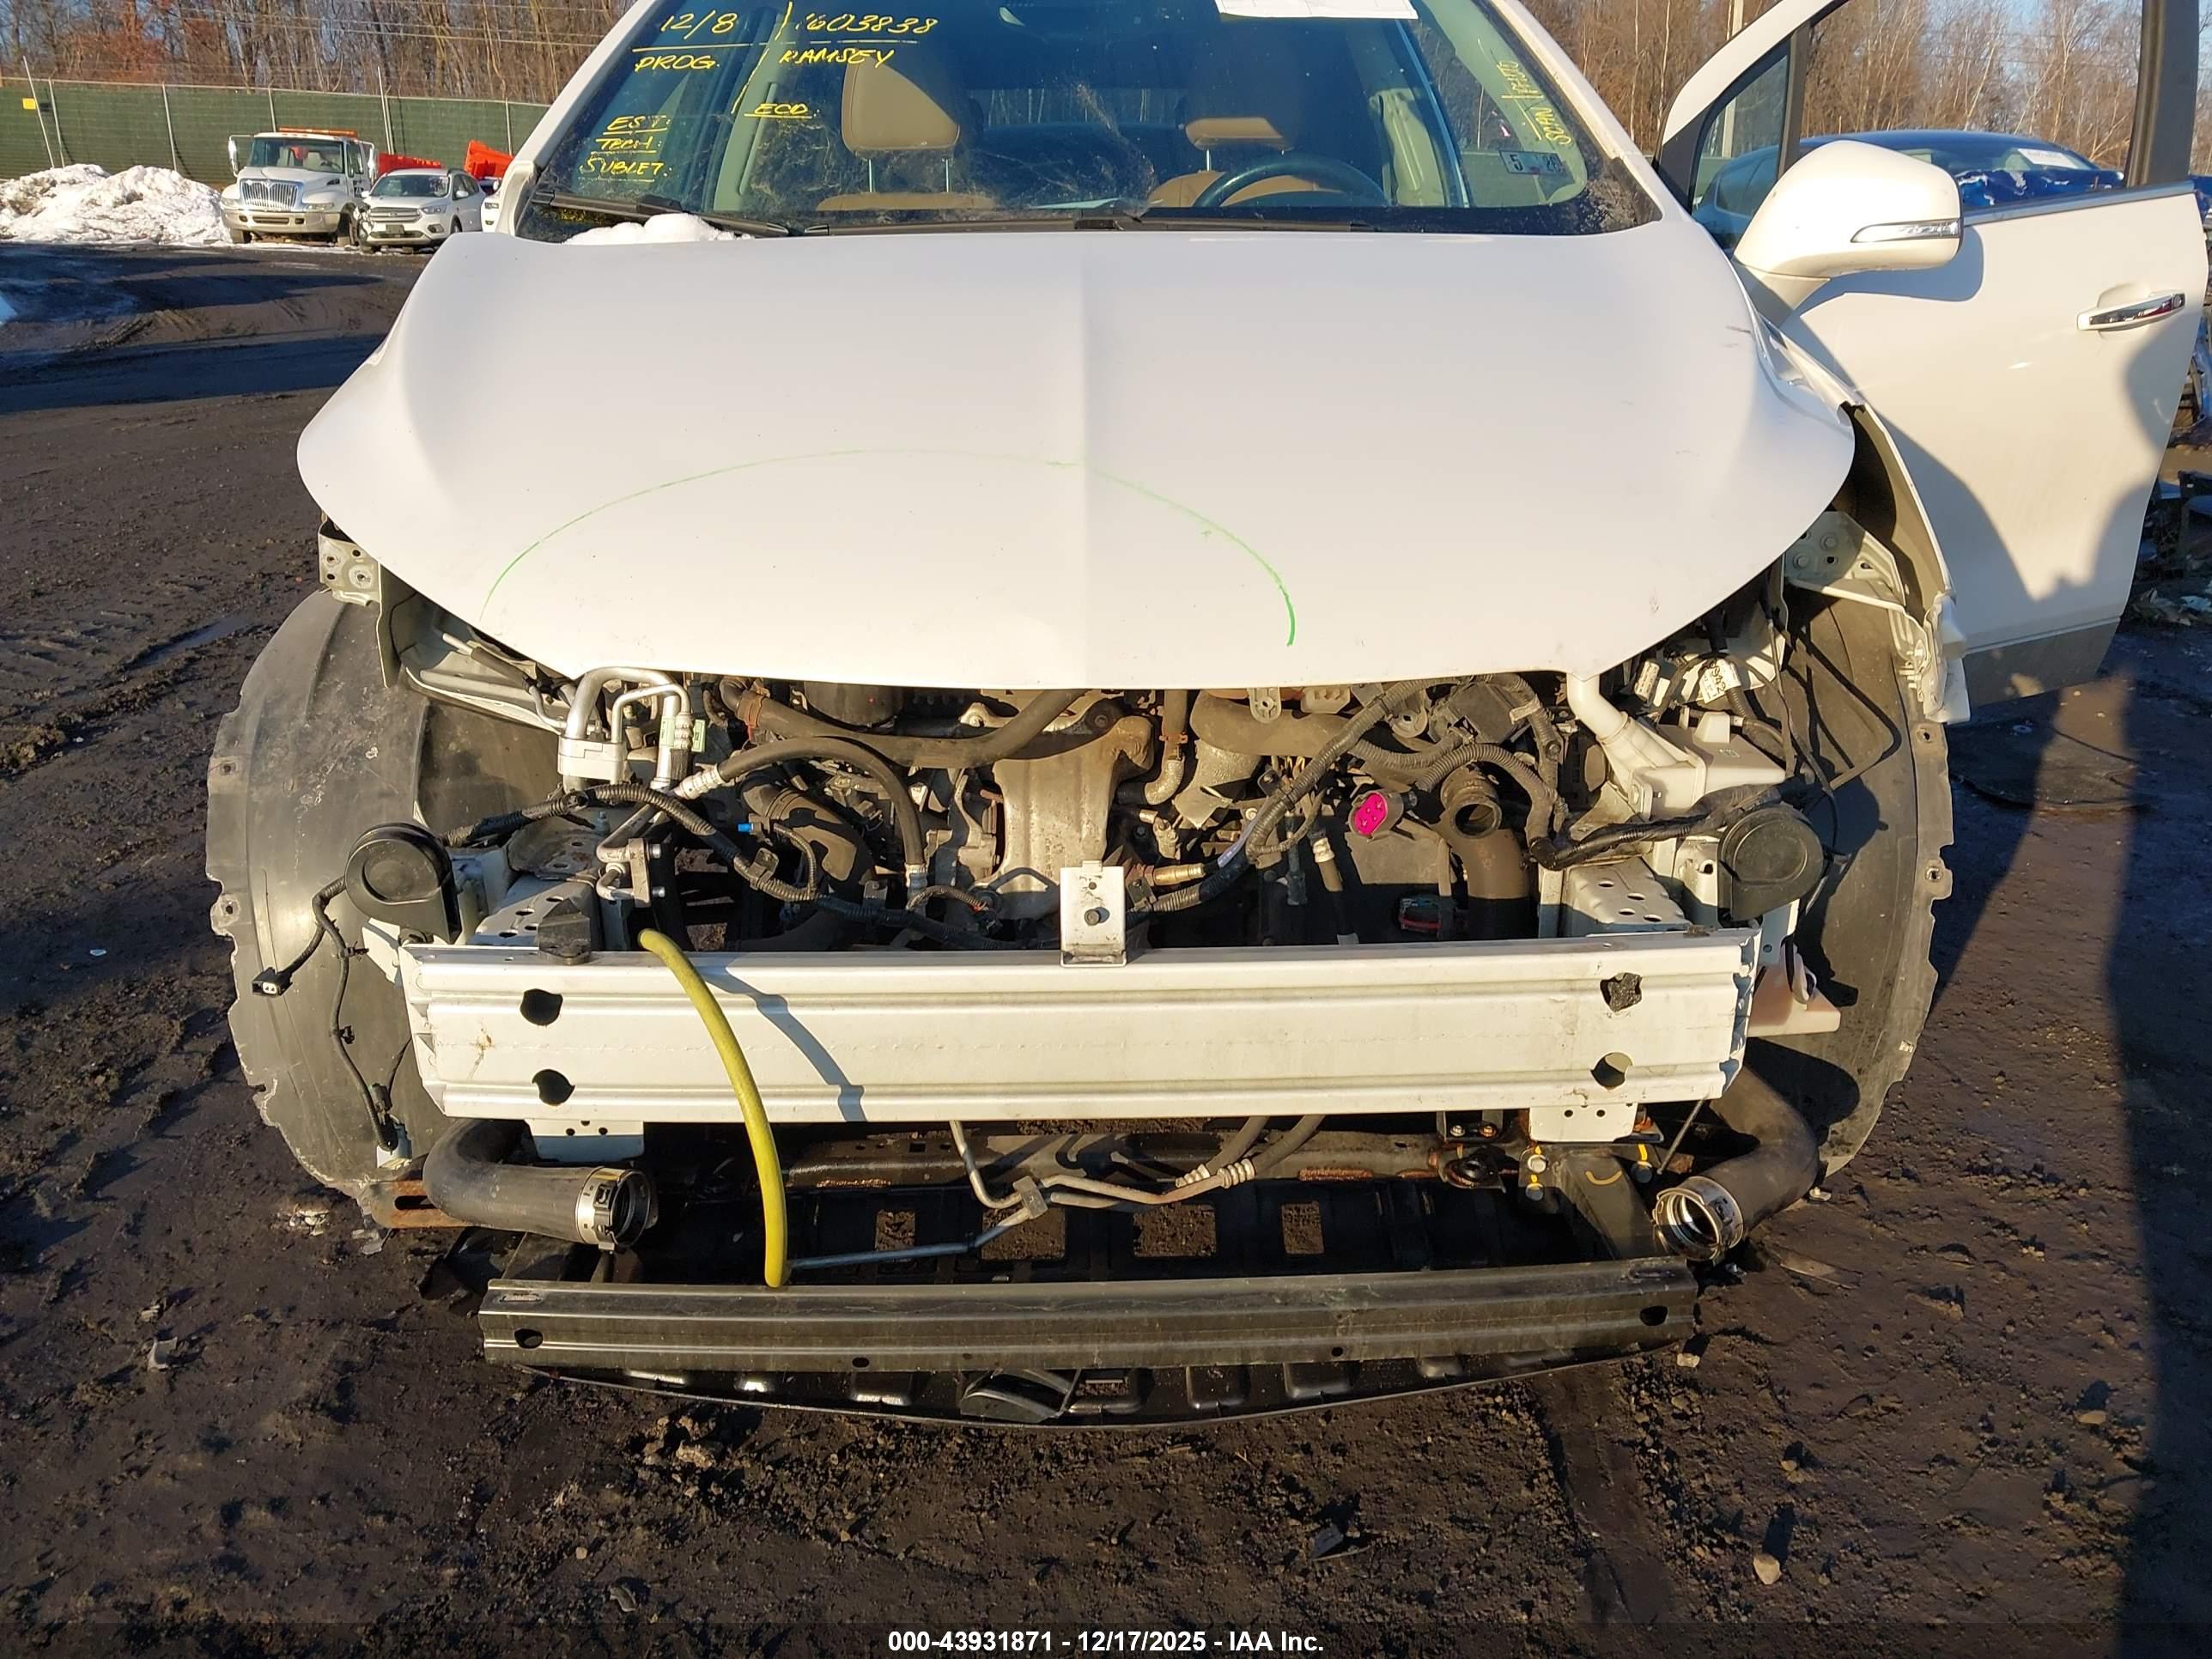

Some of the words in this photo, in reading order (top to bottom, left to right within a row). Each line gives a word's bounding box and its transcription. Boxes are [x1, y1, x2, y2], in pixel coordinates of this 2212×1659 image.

[660, 9, 738, 40] 12/8
[779, 47, 895, 68] RAMSEY
[1528, 106, 1572, 145] SCAN
[1510, 154, 1524, 171] 5
